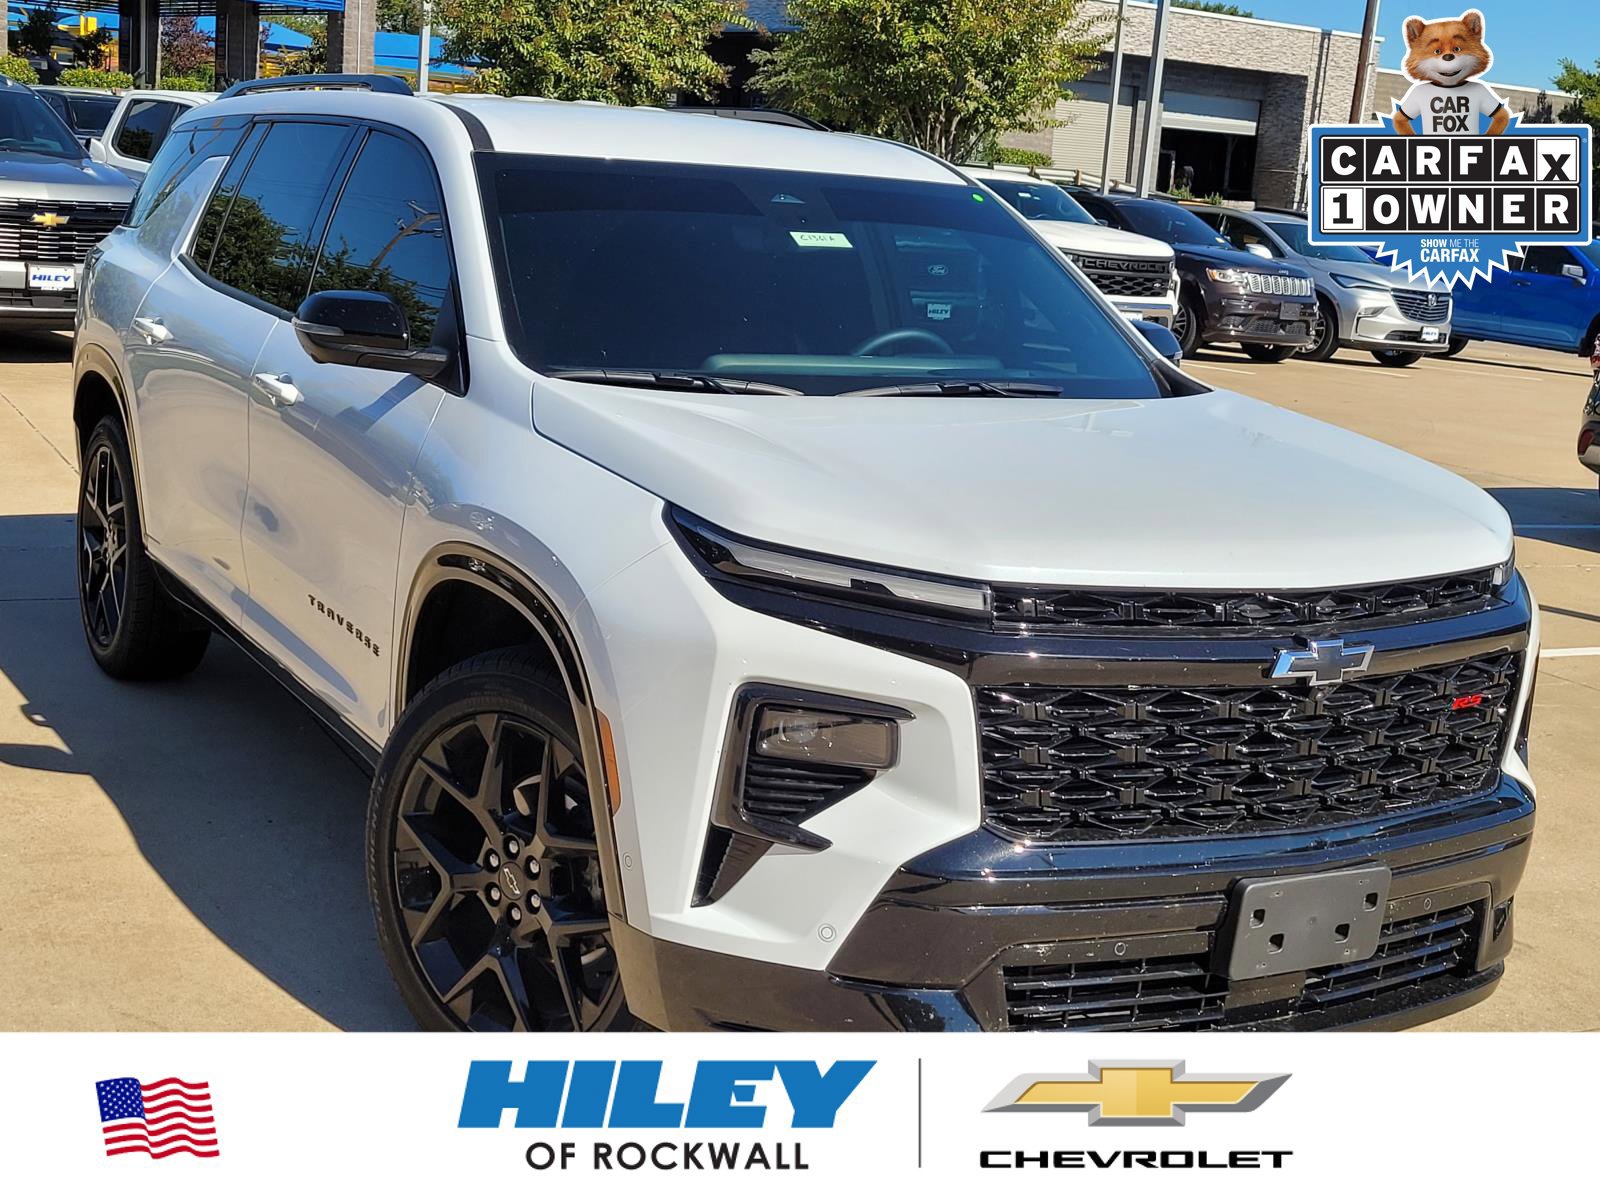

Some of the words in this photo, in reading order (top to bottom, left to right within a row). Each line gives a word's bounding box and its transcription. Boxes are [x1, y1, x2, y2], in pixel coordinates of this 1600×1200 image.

[1083, 257, 1169, 274] CHEVROLET
[31, 274, 72, 282] HILEY
[308, 594, 380, 657] TRAVERSE
[1451, 694, 1482, 710] RS
